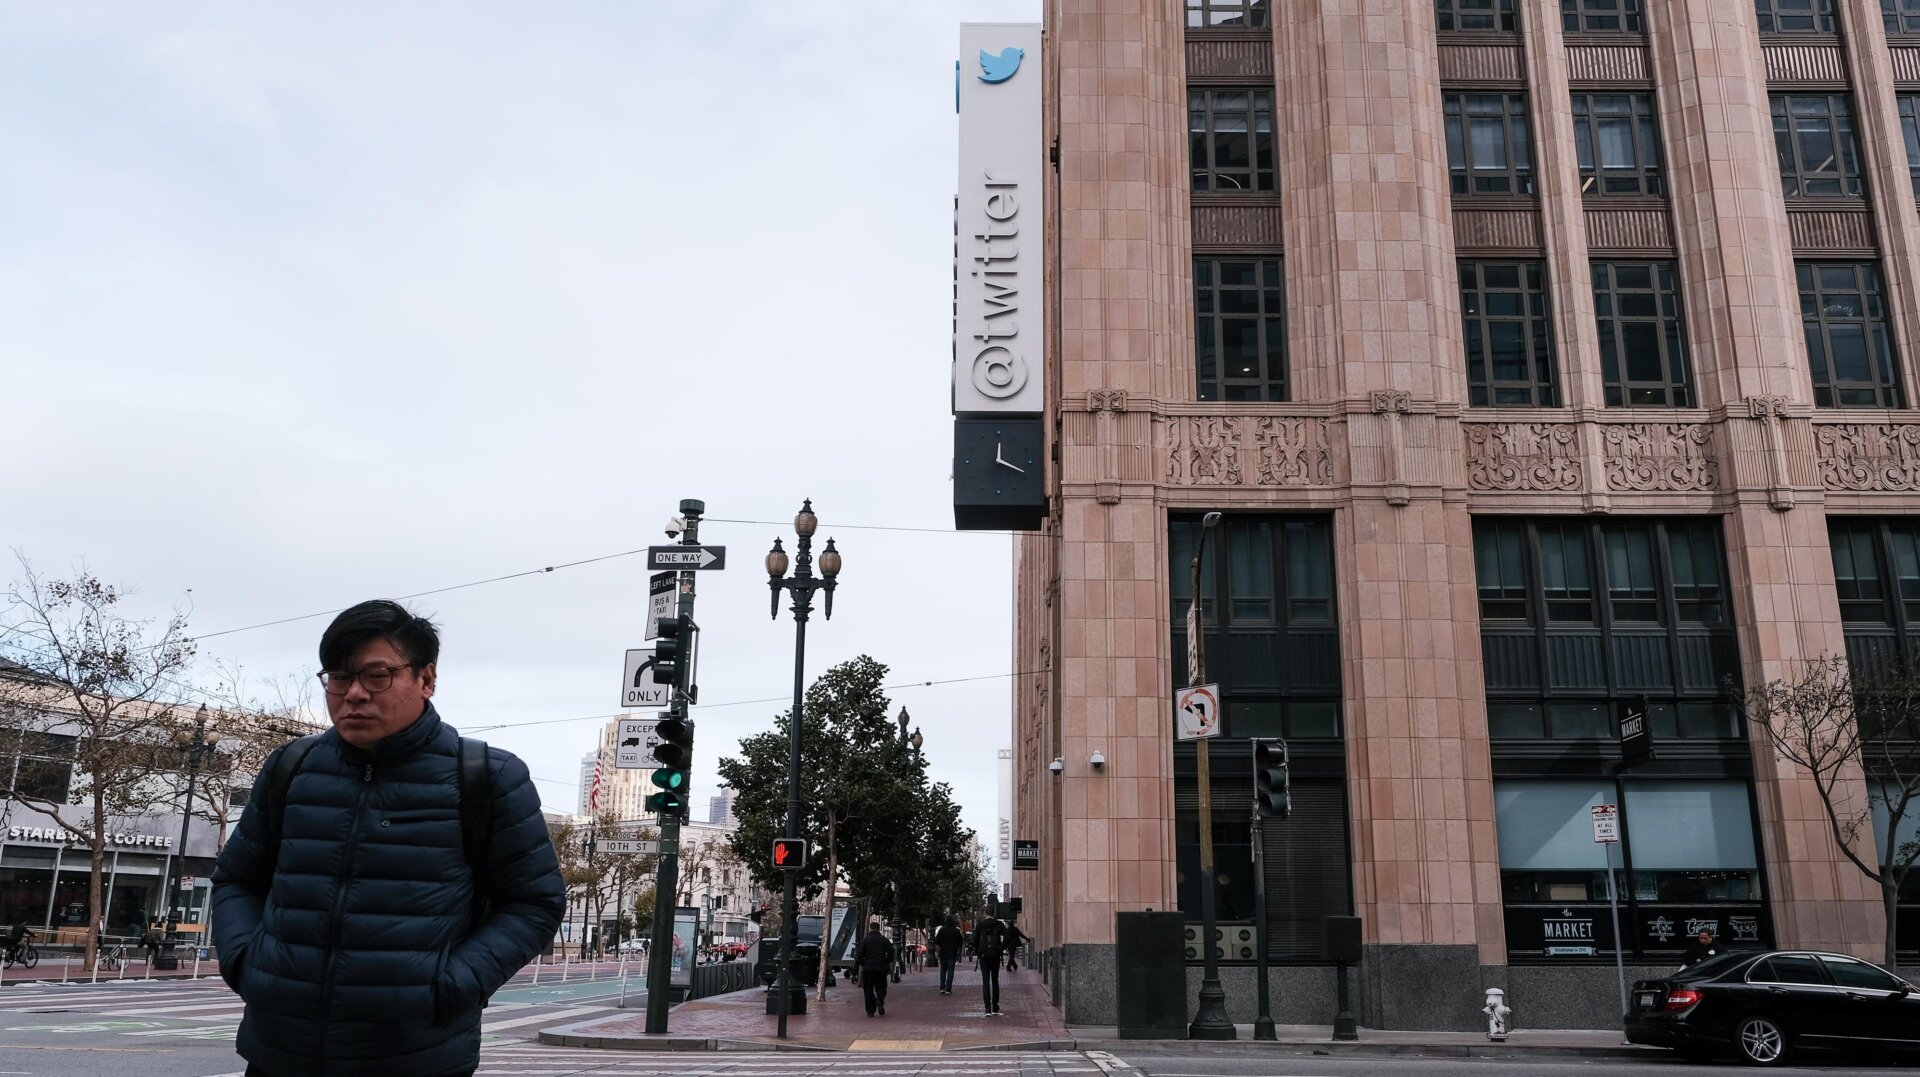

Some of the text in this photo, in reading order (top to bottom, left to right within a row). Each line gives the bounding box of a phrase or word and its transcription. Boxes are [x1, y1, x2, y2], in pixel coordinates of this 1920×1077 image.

[971, 168, 1028, 398] @twitter
[657, 553, 702, 562] ONE WAY
[650, 576, 676, 590] LEFT LANE
[655, 597, 665, 607] BUS
[656, 607, 667, 615] TAXI
[628, 690, 662, 702] ONLY
[1621, 717, 1642, 738] MARKET
[9, 825, 173, 847] STARBUS COFFEE
[1000, 818, 1010, 860] DOLBY
[606, 842, 648, 851] 10TH ST
[1543, 922, 1593, 938] MARKET
